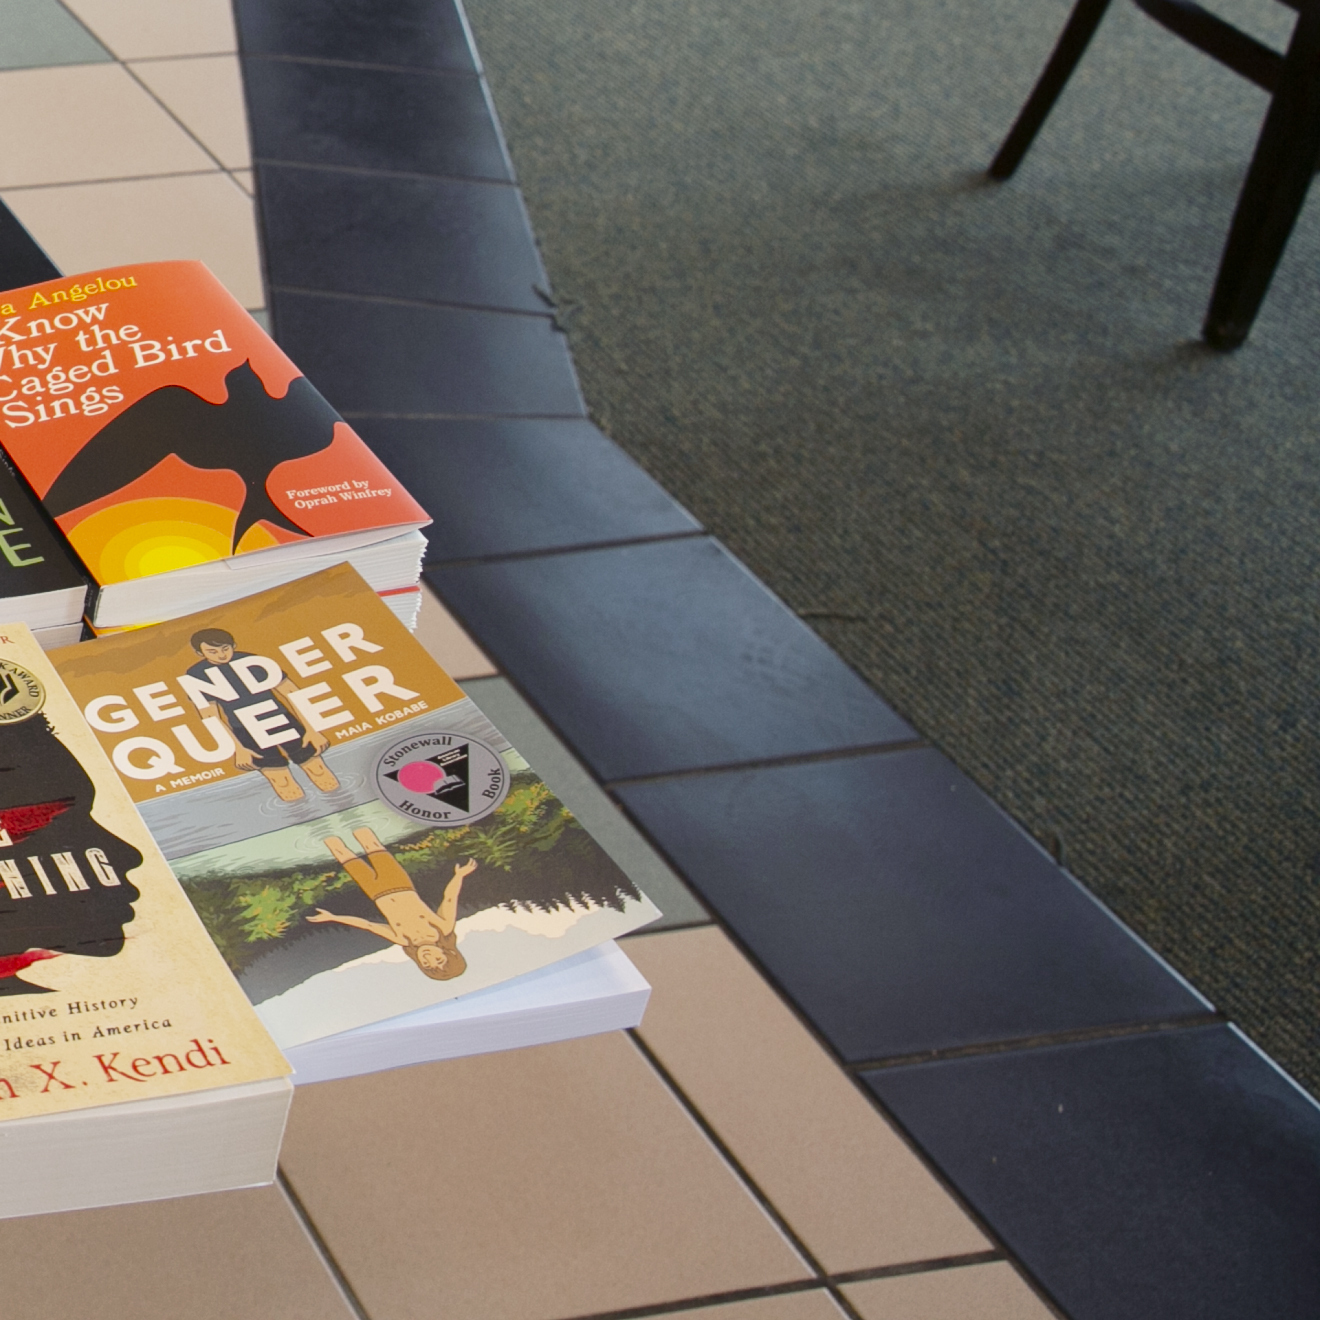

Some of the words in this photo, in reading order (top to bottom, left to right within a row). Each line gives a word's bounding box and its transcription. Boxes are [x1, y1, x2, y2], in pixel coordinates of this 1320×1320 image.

[27, 273, 138, 310] Angelou
[74, 323, 143, 354] the
[129, 329, 232, 369] Bird
[3, 385, 125, 431] Sings
[285, 481, 347, 501] Foreword
[351, 478, 370, 492] by
[294, 493, 337, 511] Oprah
[340, 485, 393, 505] Winfrey
[83, 621, 386, 734] GENDER
[110, 663, 421, 781] QUEER
[334, 721, 373, 741] MAIA
[375, 699, 430, 726] KOBABE
[383, 735, 453, 768] Stonewall
[169, 766, 226, 790] MEMOIR
[481, 767, 502, 800] Book
[399, 799, 452, 820] Honor
[68, 994, 141, 1018] History
[3, 1034, 56, 1053] Ideas
[91, 1018, 173, 1042] America
[30, 1059, 89, 1093] X.
[93, 1036, 232, 1087] Kendi
